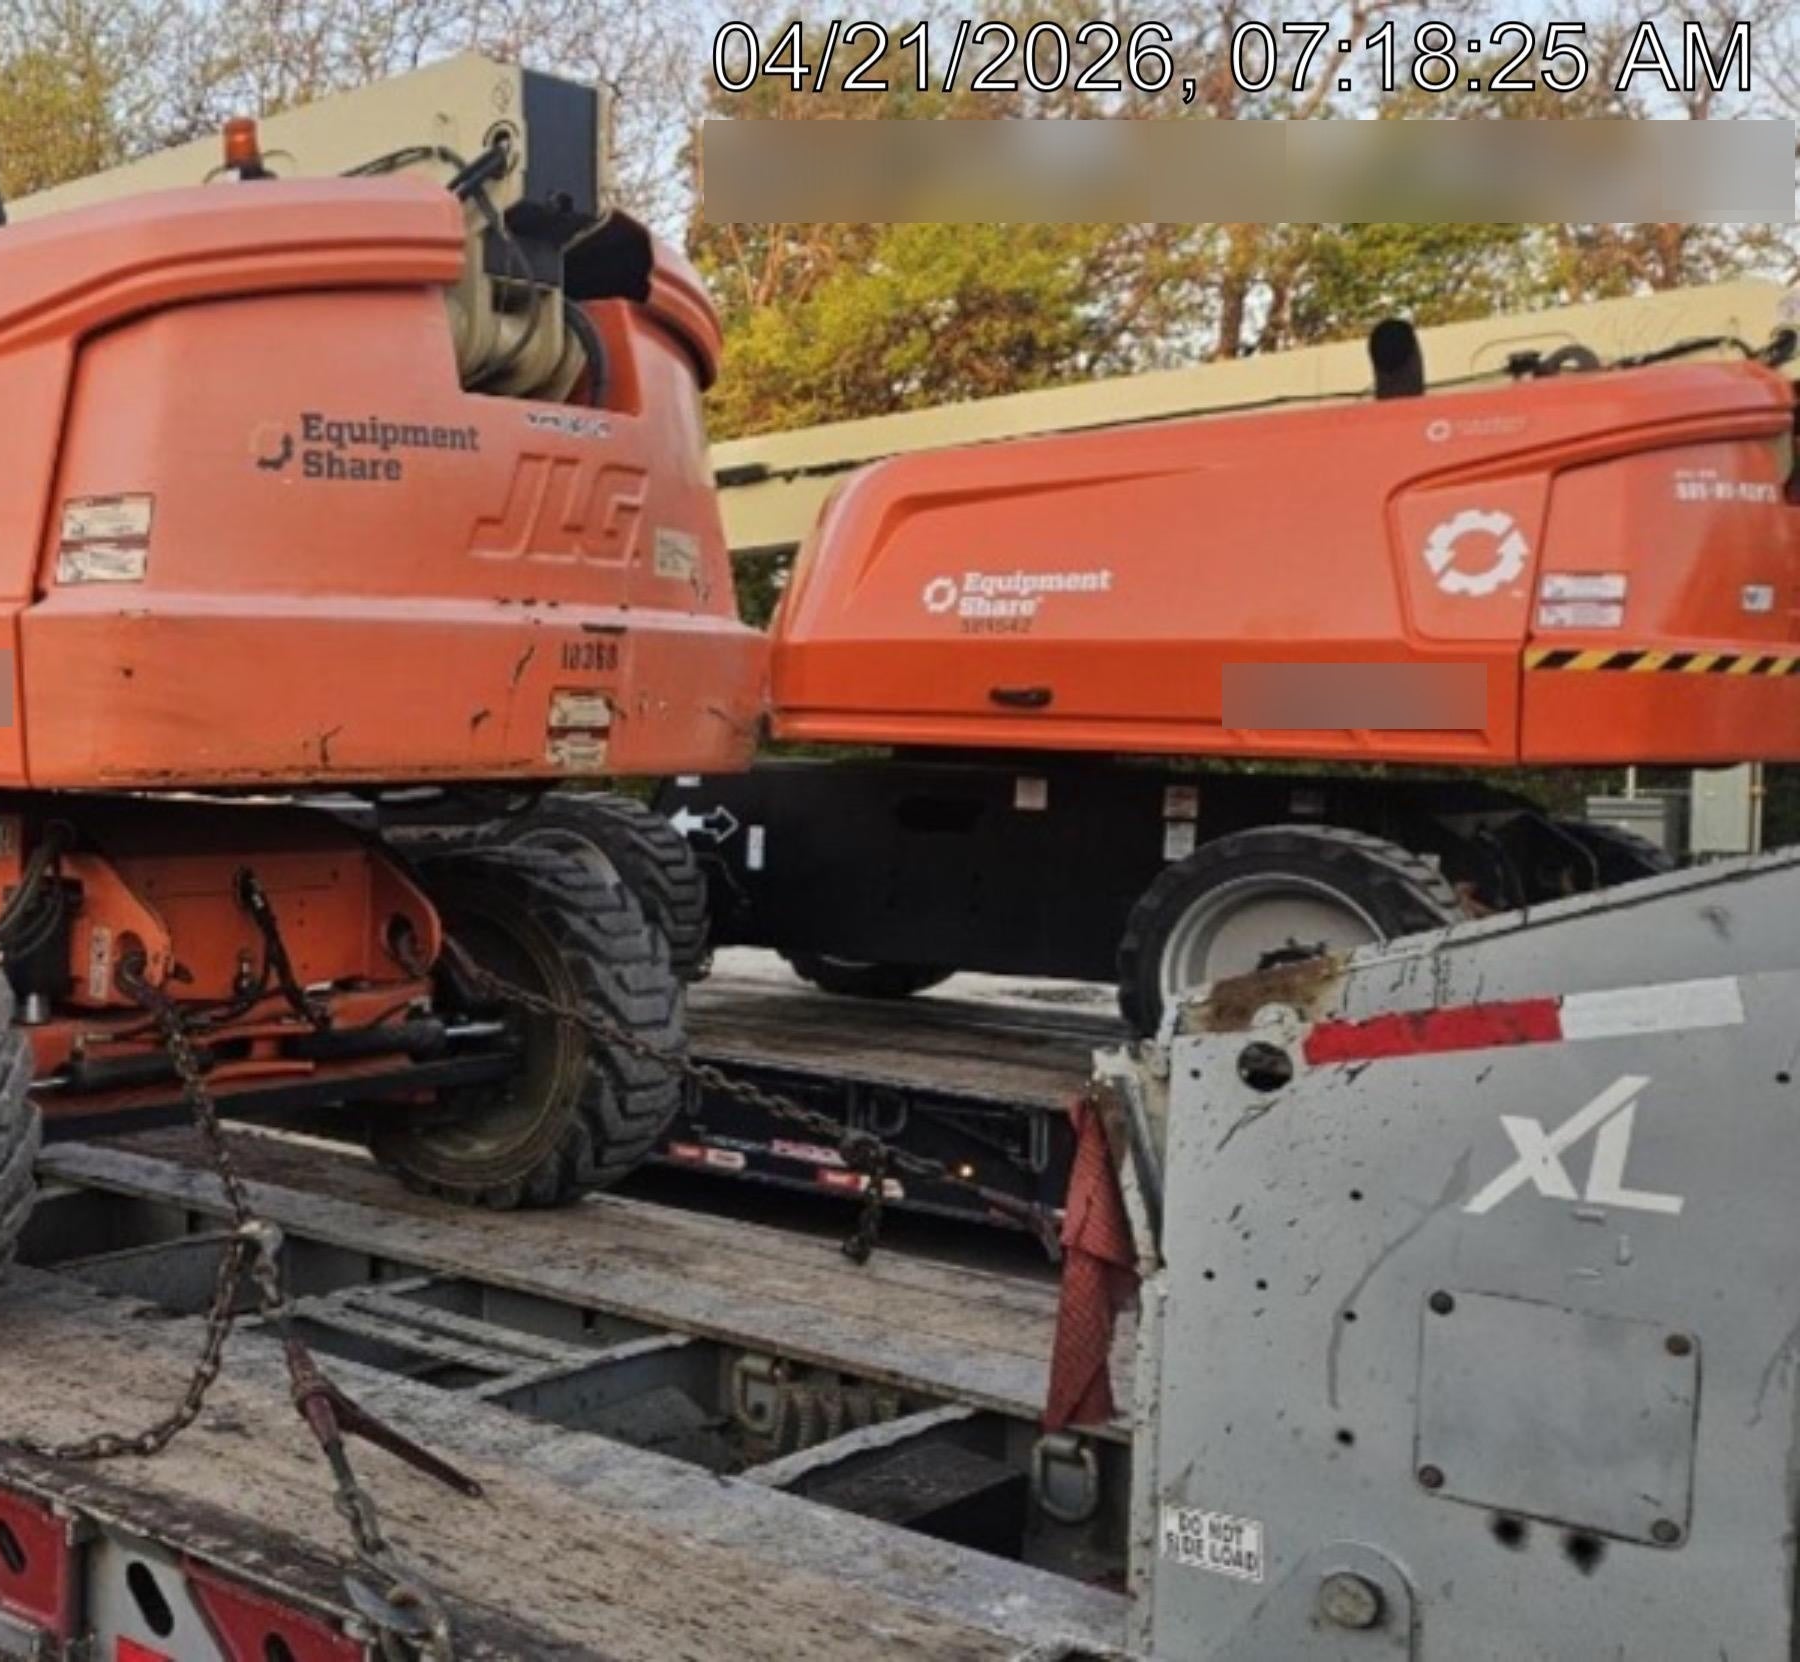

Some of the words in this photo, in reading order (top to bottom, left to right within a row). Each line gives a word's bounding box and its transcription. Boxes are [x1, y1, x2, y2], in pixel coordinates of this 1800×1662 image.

[300, 412, 481, 452] Equipment
[302, 449, 404, 482] Share
[469, 451, 649, 569] JLG
[962, 568, 1114, 597] Equipment
[1461, 1074, 1686, 1215] XL
[1178, 1511, 1202, 1537] DO
[1208, 1518, 1243, 1546] NOT
[1208, 1541, 1258, 1573] LOAD
